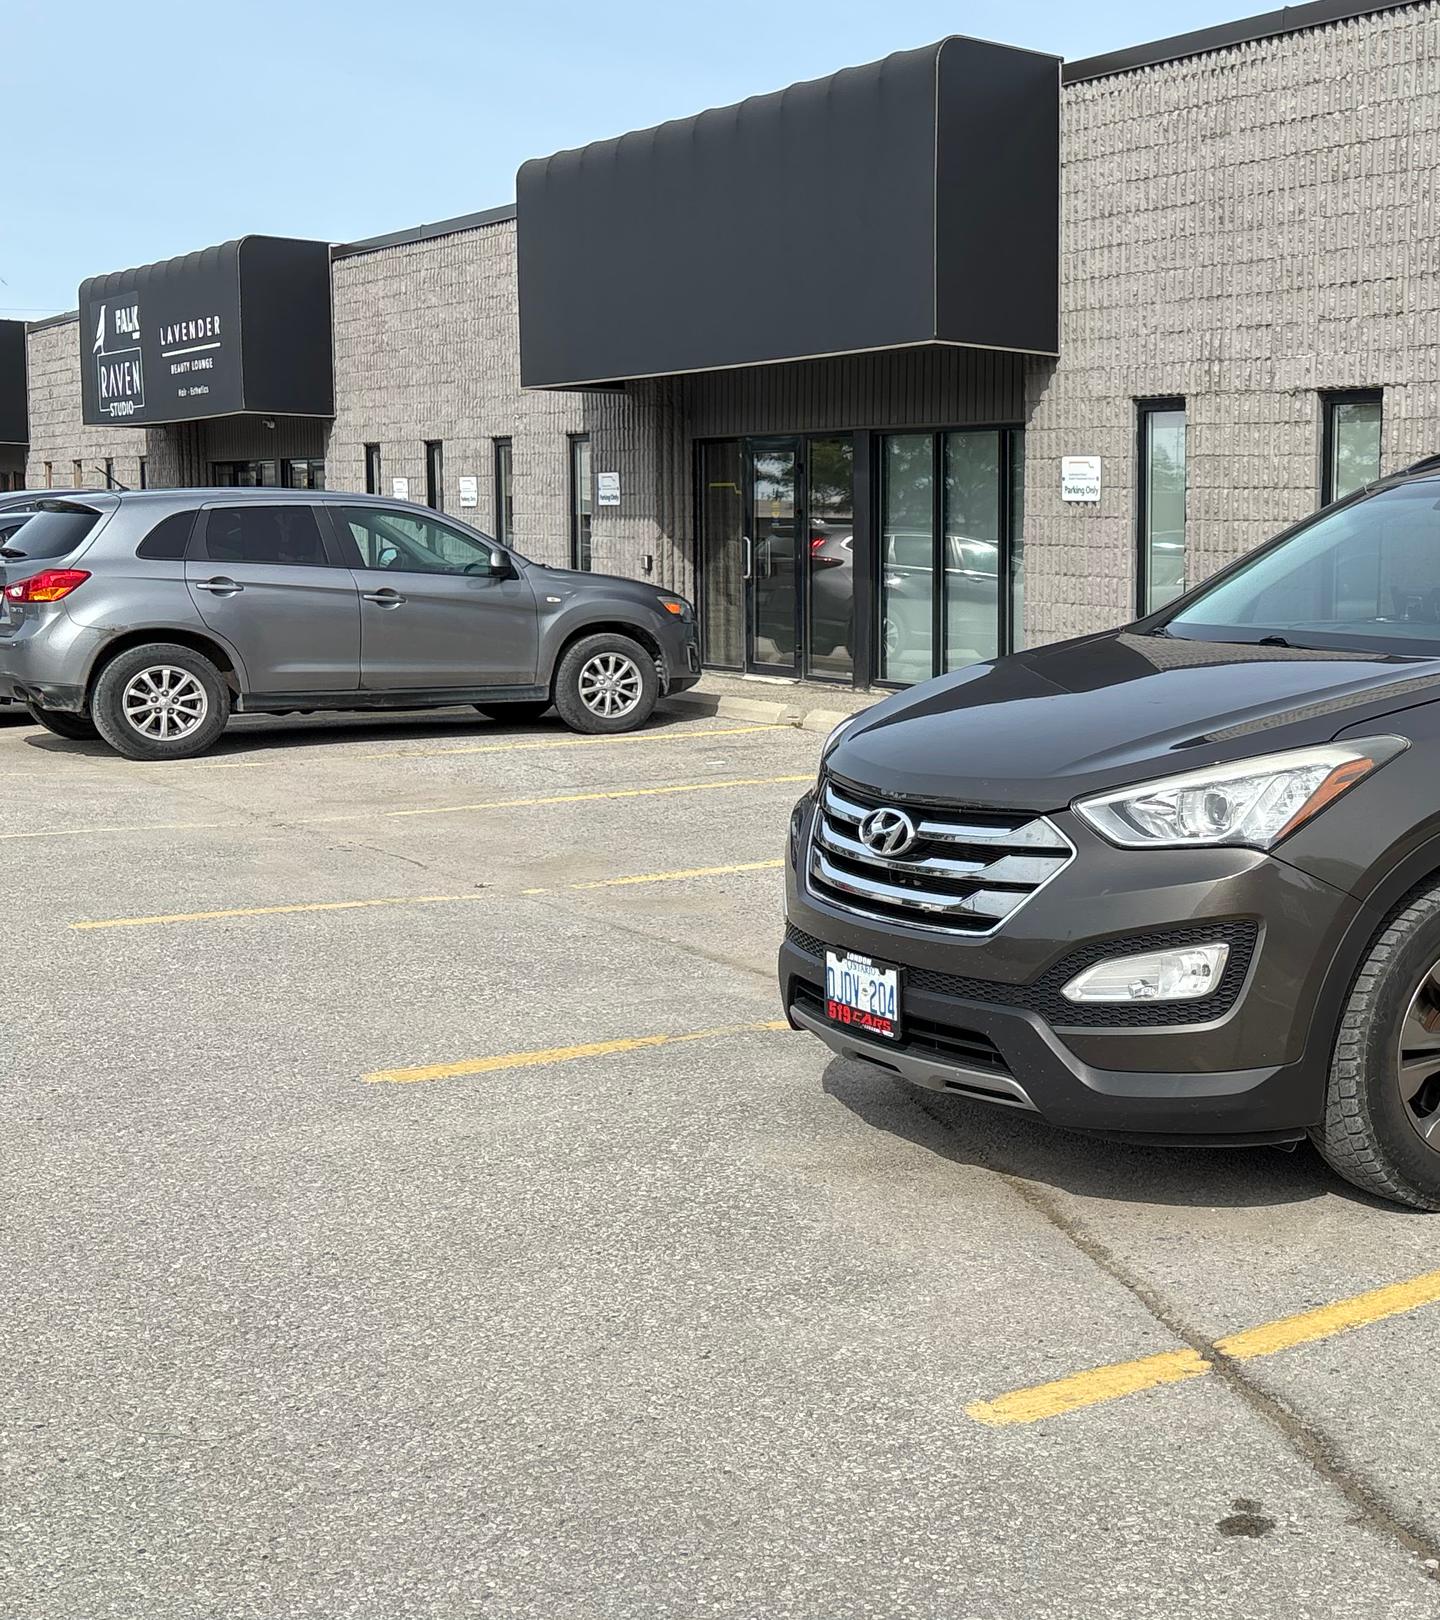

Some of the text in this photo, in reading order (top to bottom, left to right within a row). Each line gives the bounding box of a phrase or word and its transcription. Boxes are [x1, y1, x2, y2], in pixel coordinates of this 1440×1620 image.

[115, 305, 140, 334] FALK
[160, 316, 221, 345] LAVENDER
[170, 358, 213, 375] BEAUTY LOUNGE
[101, 361, 140, 398] RAVEN
[110, 401, 134, 417] STUDIO
[1064, 485, 1099, 496] Parking Only
[846, 952, 872, 966] LONDON
